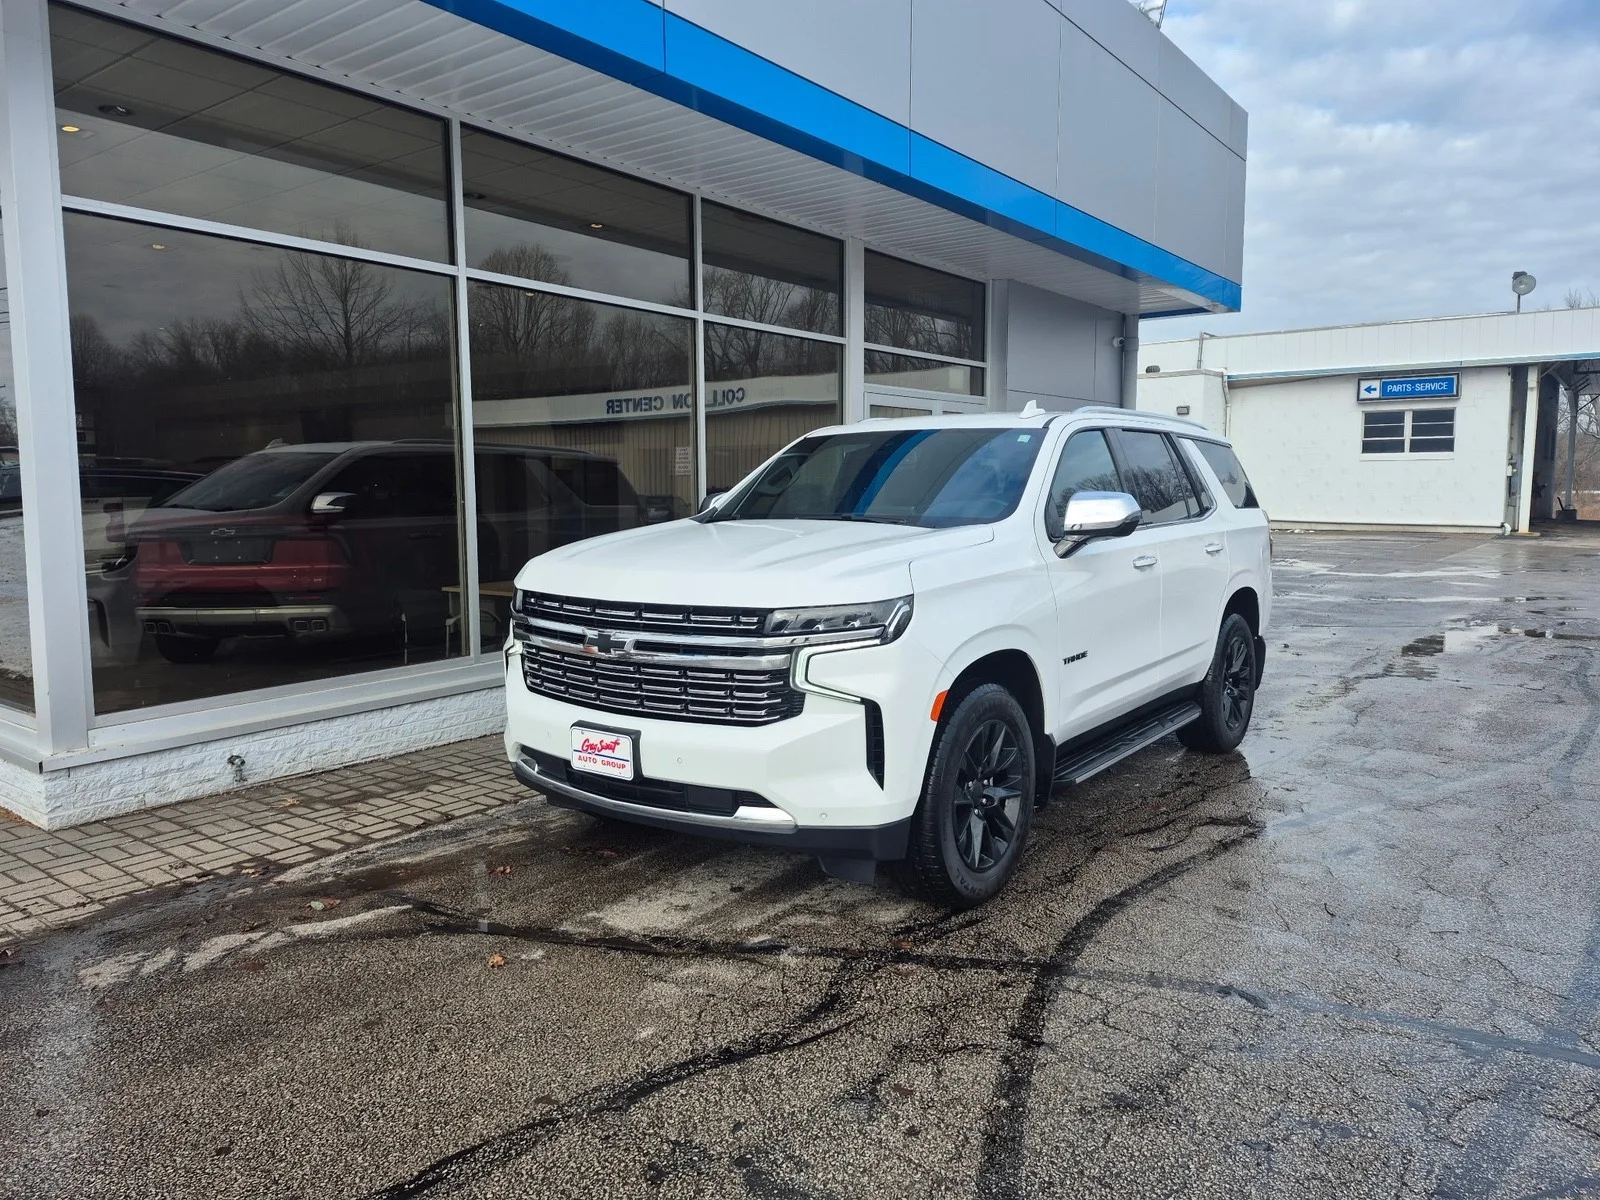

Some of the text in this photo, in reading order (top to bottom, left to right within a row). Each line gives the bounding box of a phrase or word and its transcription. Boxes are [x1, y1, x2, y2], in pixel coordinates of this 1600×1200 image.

[1387, 381, 1448, 393] PARTS-SERVICE
[578, 755, 627, 770] AUTO GROUP
